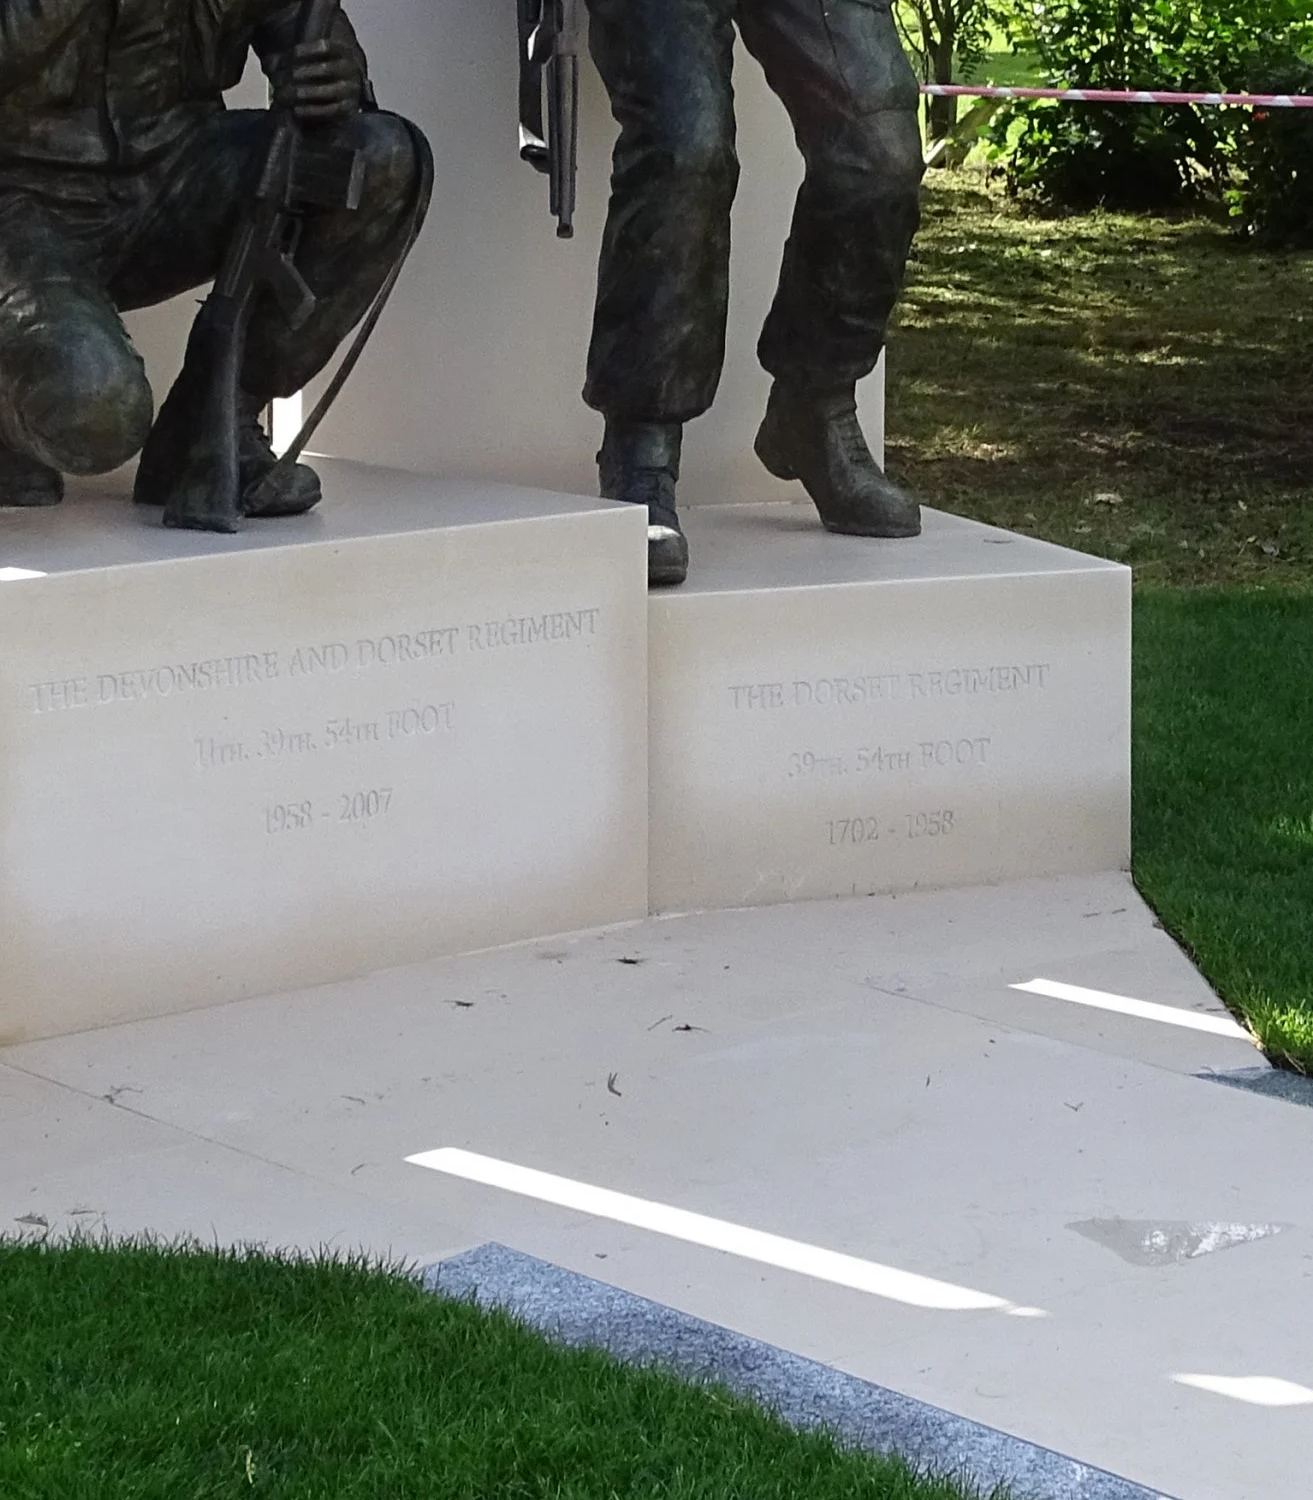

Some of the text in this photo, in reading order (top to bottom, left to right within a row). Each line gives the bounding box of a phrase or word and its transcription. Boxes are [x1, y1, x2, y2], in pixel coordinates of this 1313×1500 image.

[29, 607, 601, 714] THE DEVONSHIRE AND DORSET REGIMENT
[728, 663, 1051, 710] THE DORSET REGIMENT
[385, 700, 455, 735] FOOT
[919, 737, 992, 768] FOOT
[264, 800, 312, 834] 1958
[339, 786, 394, 824] 2007
[826, 817, 880, 845] 1702
[905, 810, 955, 839] 1958
